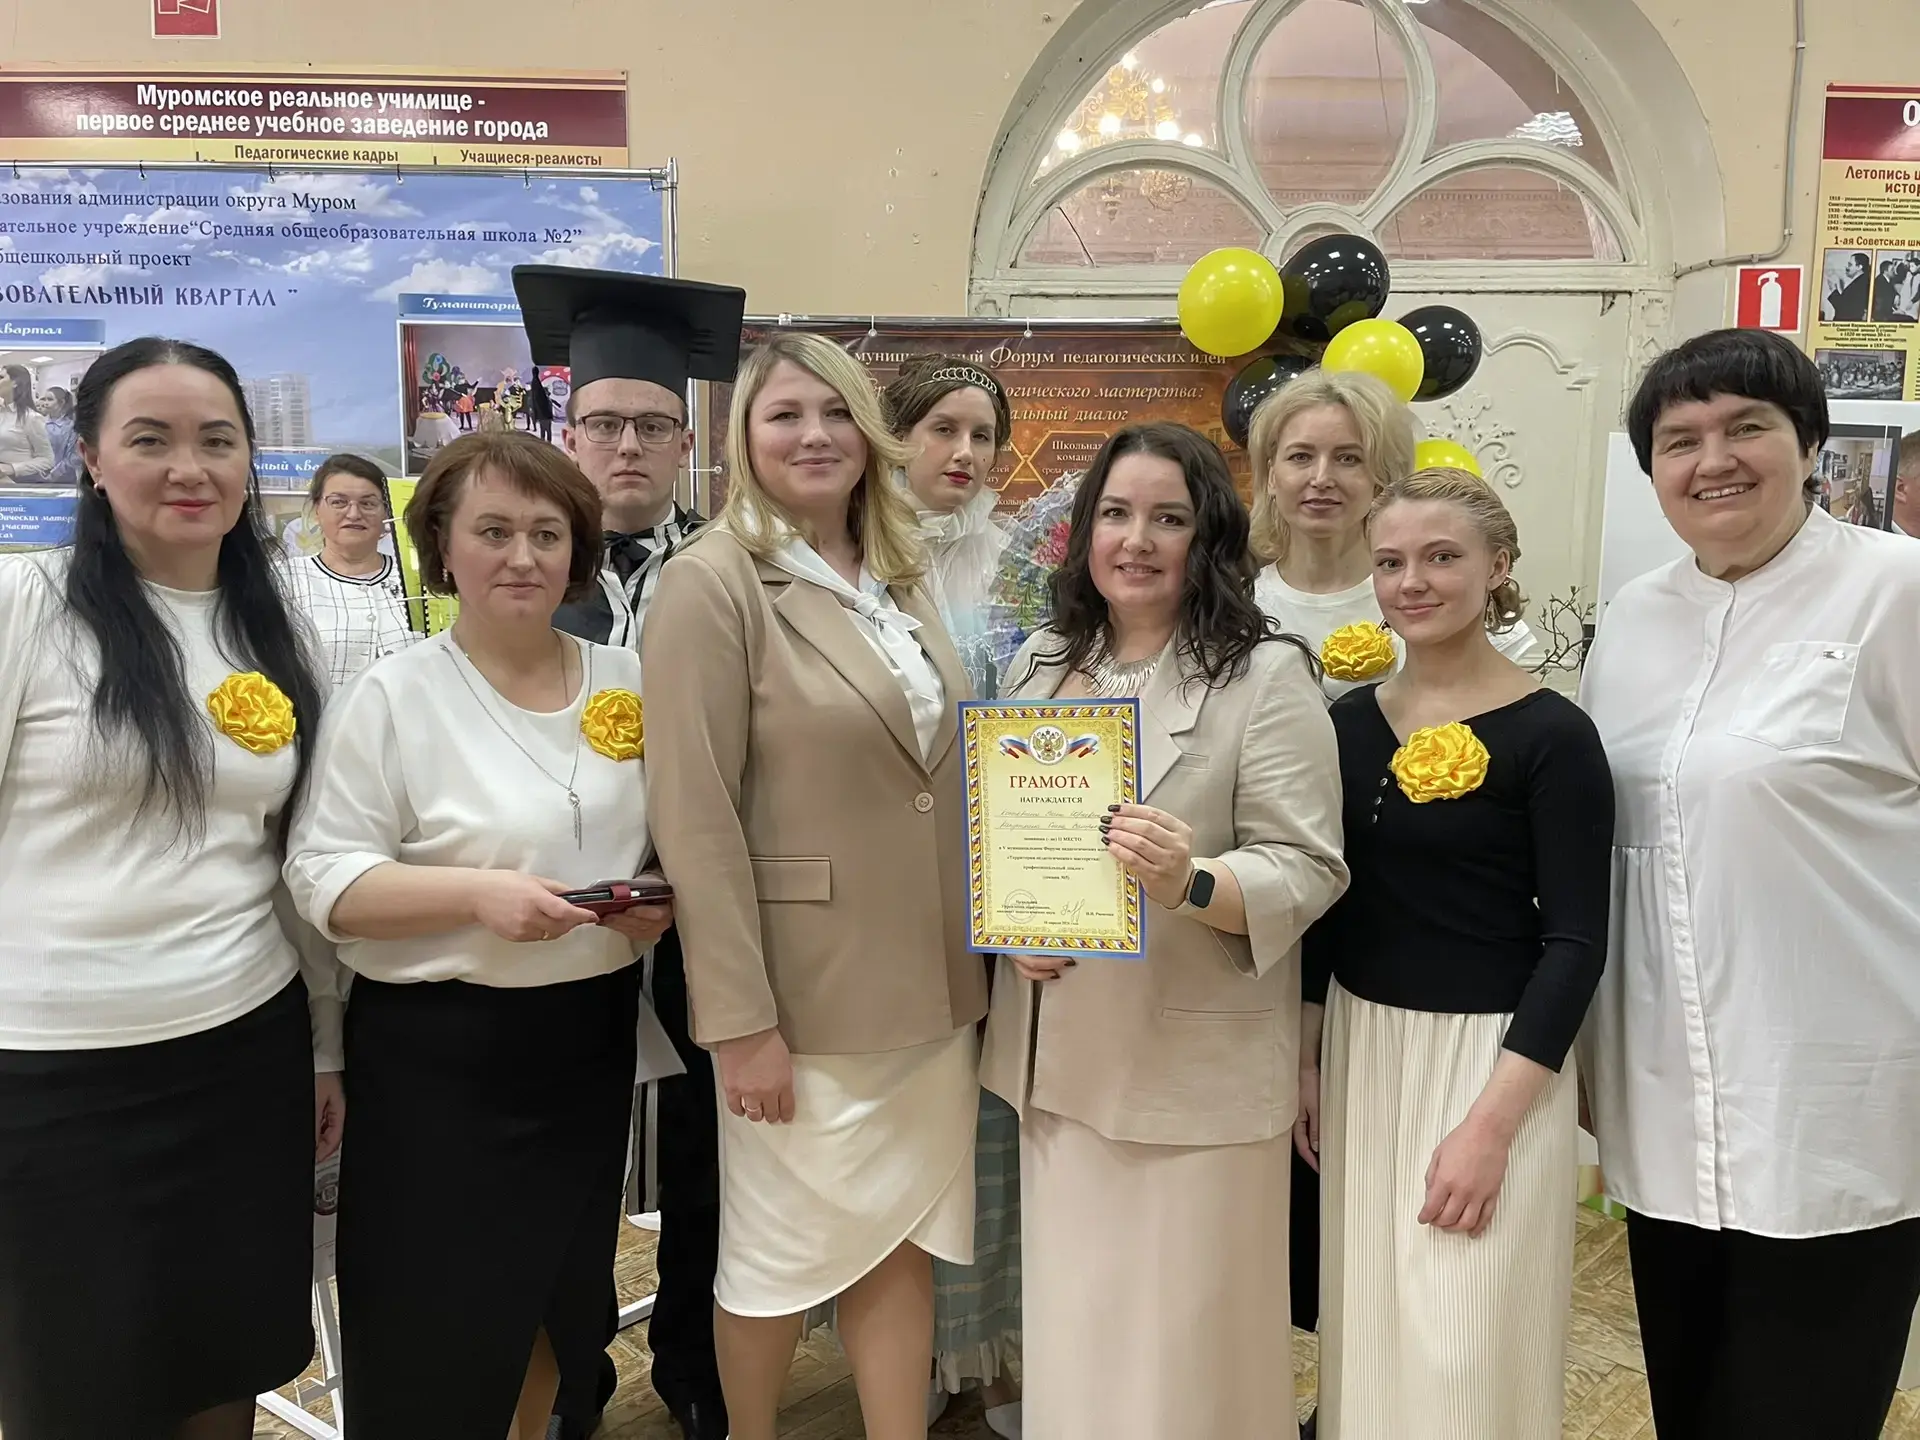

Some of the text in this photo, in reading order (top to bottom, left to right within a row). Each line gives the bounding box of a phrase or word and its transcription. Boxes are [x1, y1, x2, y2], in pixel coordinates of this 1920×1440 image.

[136, 84, 263, 110] Муромское
[269, 88, 373, 112] реальное
[377, 91, 473, 114] училище
[76, 110, 549, 141] первое среднее учебное заведение города
[234, 144, 350, 162] Педагогические
[353, 150, 399, 164] кадры
[460, 150, 602, 167] Учащиеся-реалисты
[1845, 166, 1910, 180] Летопись
[0, 192, 356, 212] зования администрации округа Муром
[0, 222, 77, 234] ательное
[82, 222, 189, 238] учреждение
[281, 224, 476, 242] общеобразовательная
[482, 229, 538, 243] школа
[1834, 236, 1854, 246] 1-ая
[1856, 236, 1906, 246] Советская
[128, 252, 192, 270] проект
[0, 284, 164, 305] ОВАТЕЛЬНЫЙ
[176, 288, 276, 306] КВАРТАЛ
[0, 322, 62, 336] вартал
[854, 350, 984, 365] муницый
[990, 345, 1054, 368] Форум
[1063, 352, 1186, 365] педагогических
[1006, 385, 1204, 402] огического мастерства:
[1010, 406, 1129, 422] альный диалог
[295, 459, 320, 471] ква
[1056, 454, 1095, 462] команд
[1009, 775, 1090, 789] ГРАМОТА
